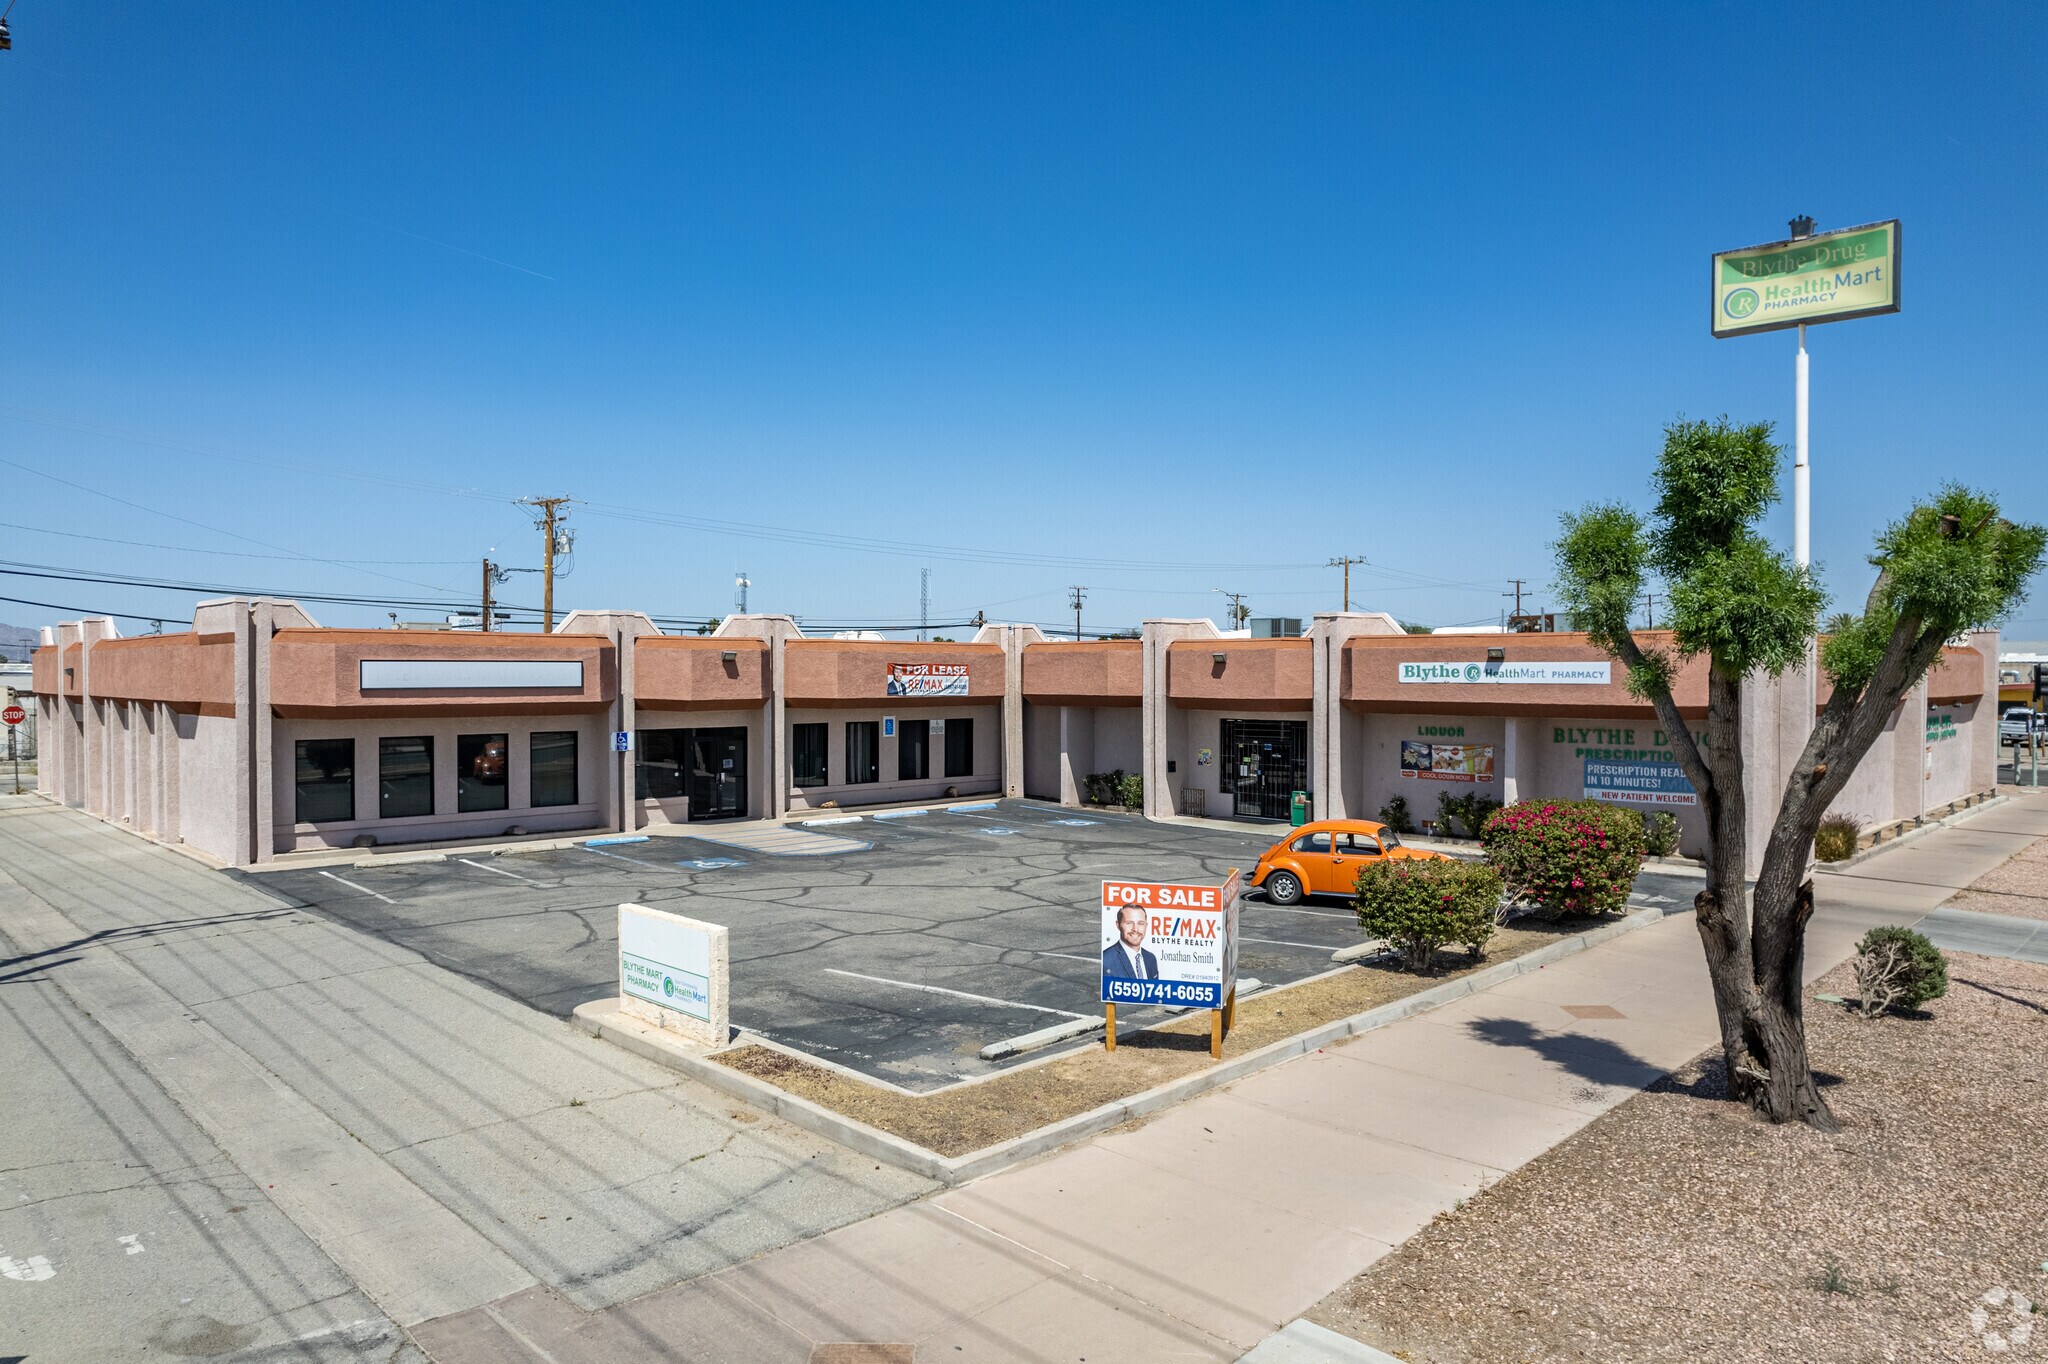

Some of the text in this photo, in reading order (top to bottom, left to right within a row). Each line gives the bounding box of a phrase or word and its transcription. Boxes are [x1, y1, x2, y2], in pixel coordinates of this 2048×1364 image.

[1742, 242, 1867, 279] Blythe Drug
[1764, 292, 1837, 311] PHARMACY
[906, 665, 967, 675] FOR LEASE
[1404, 664, 1460, 681] Blythe
[1552, 670, 1605, 679] PHARMACY
[907, 679, 944, 689] RE/MAX
[4, 711, 24, 719] STOP
[1418, 726, 1465, 738] LIQUOR
[1553, 727, 1635, 745] BLYTHE
[1575, 748, 1679, 762] PRESCRIPTIO
[1587, 764, 1658, 777] PRESCRIPTION
[1587, 775, 1597, 785] IN
[1600, 776, 1610, 786] 10
[1613, 777, 1661, 788] MINUTES!
[1601, 792, 1618, 801] NEW
[1621, 792, 1653, 802] PATIENT
[1655, 794, 1695, 804] WELCOME
[1108, 886, 1151, 904] FOR
[1158, 888, 1215, 907] SALE
[1151, 916, 1217, 939] RE/MAX
[1151, 937, 1214, 947] BLYTHE REALTY
[1160, 950, 1214, 964] Jonathan Smith
[623, 960, 663, 980] BLYTHE MART
[627, 975, 660, 993] PHARMACY
[1109, 981, 1214, 1002] (559)741-6055
